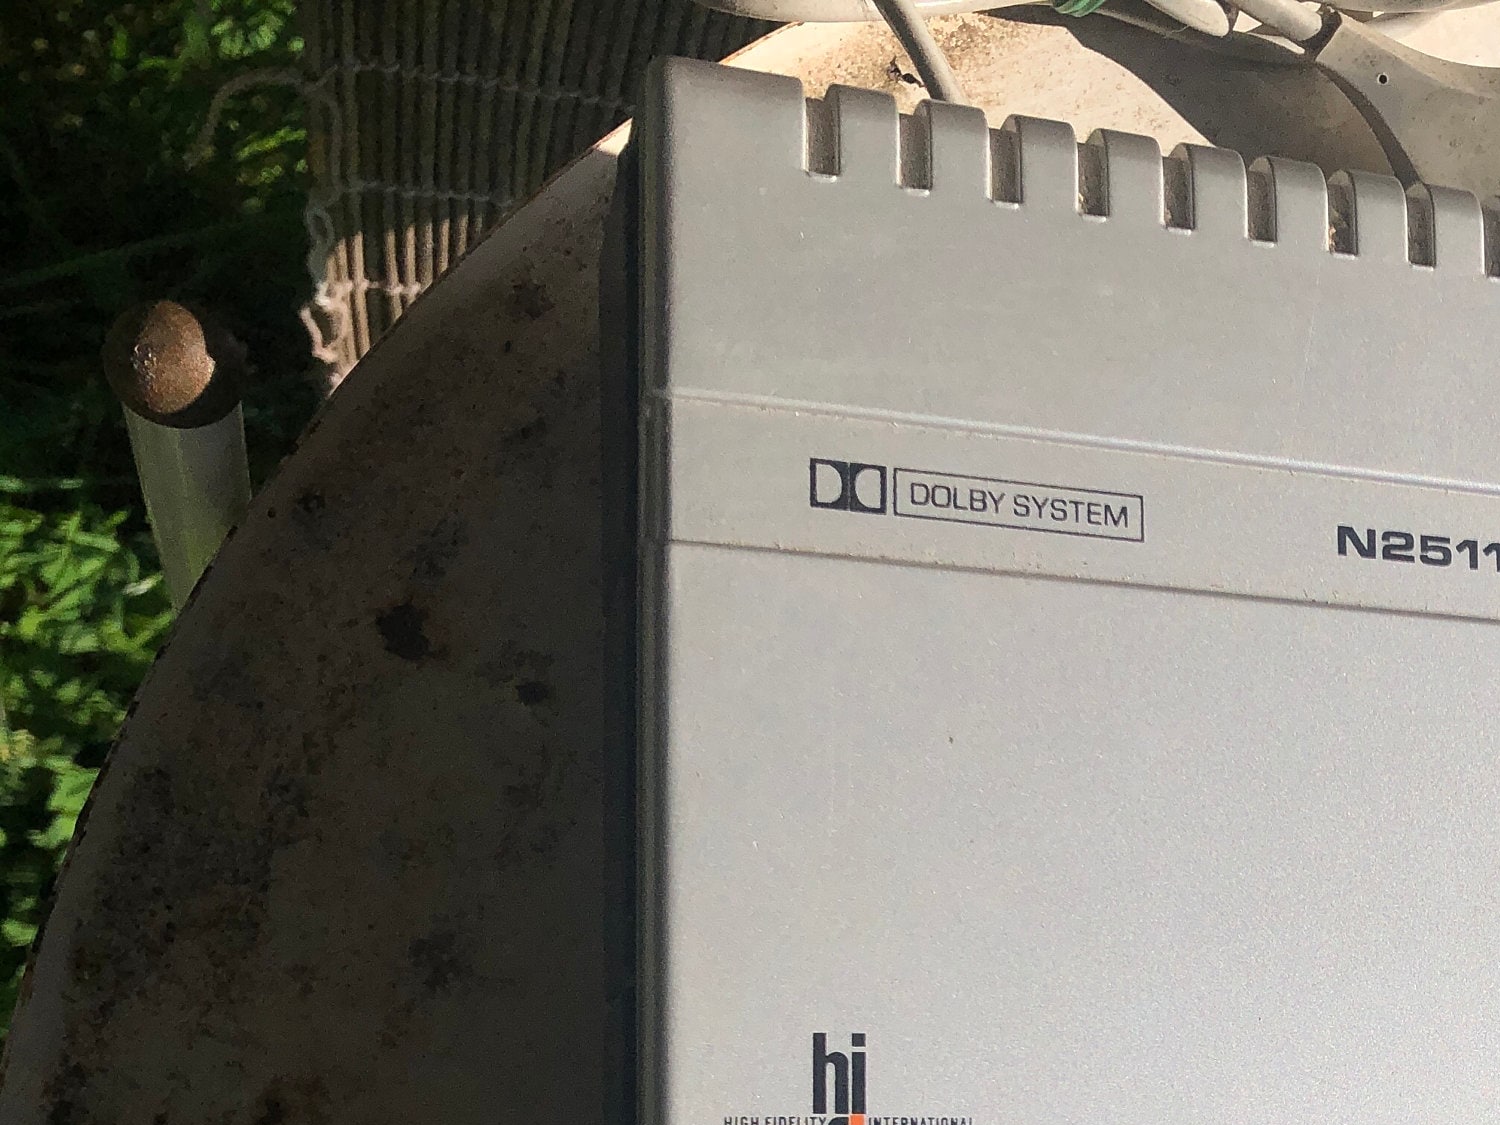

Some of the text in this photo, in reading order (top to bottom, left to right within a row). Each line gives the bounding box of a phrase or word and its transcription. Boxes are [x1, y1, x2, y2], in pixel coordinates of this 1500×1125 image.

[910, 481, 1129, 528] DOLBY SYSTEM
[812, 1032, 867, 1114] hi
